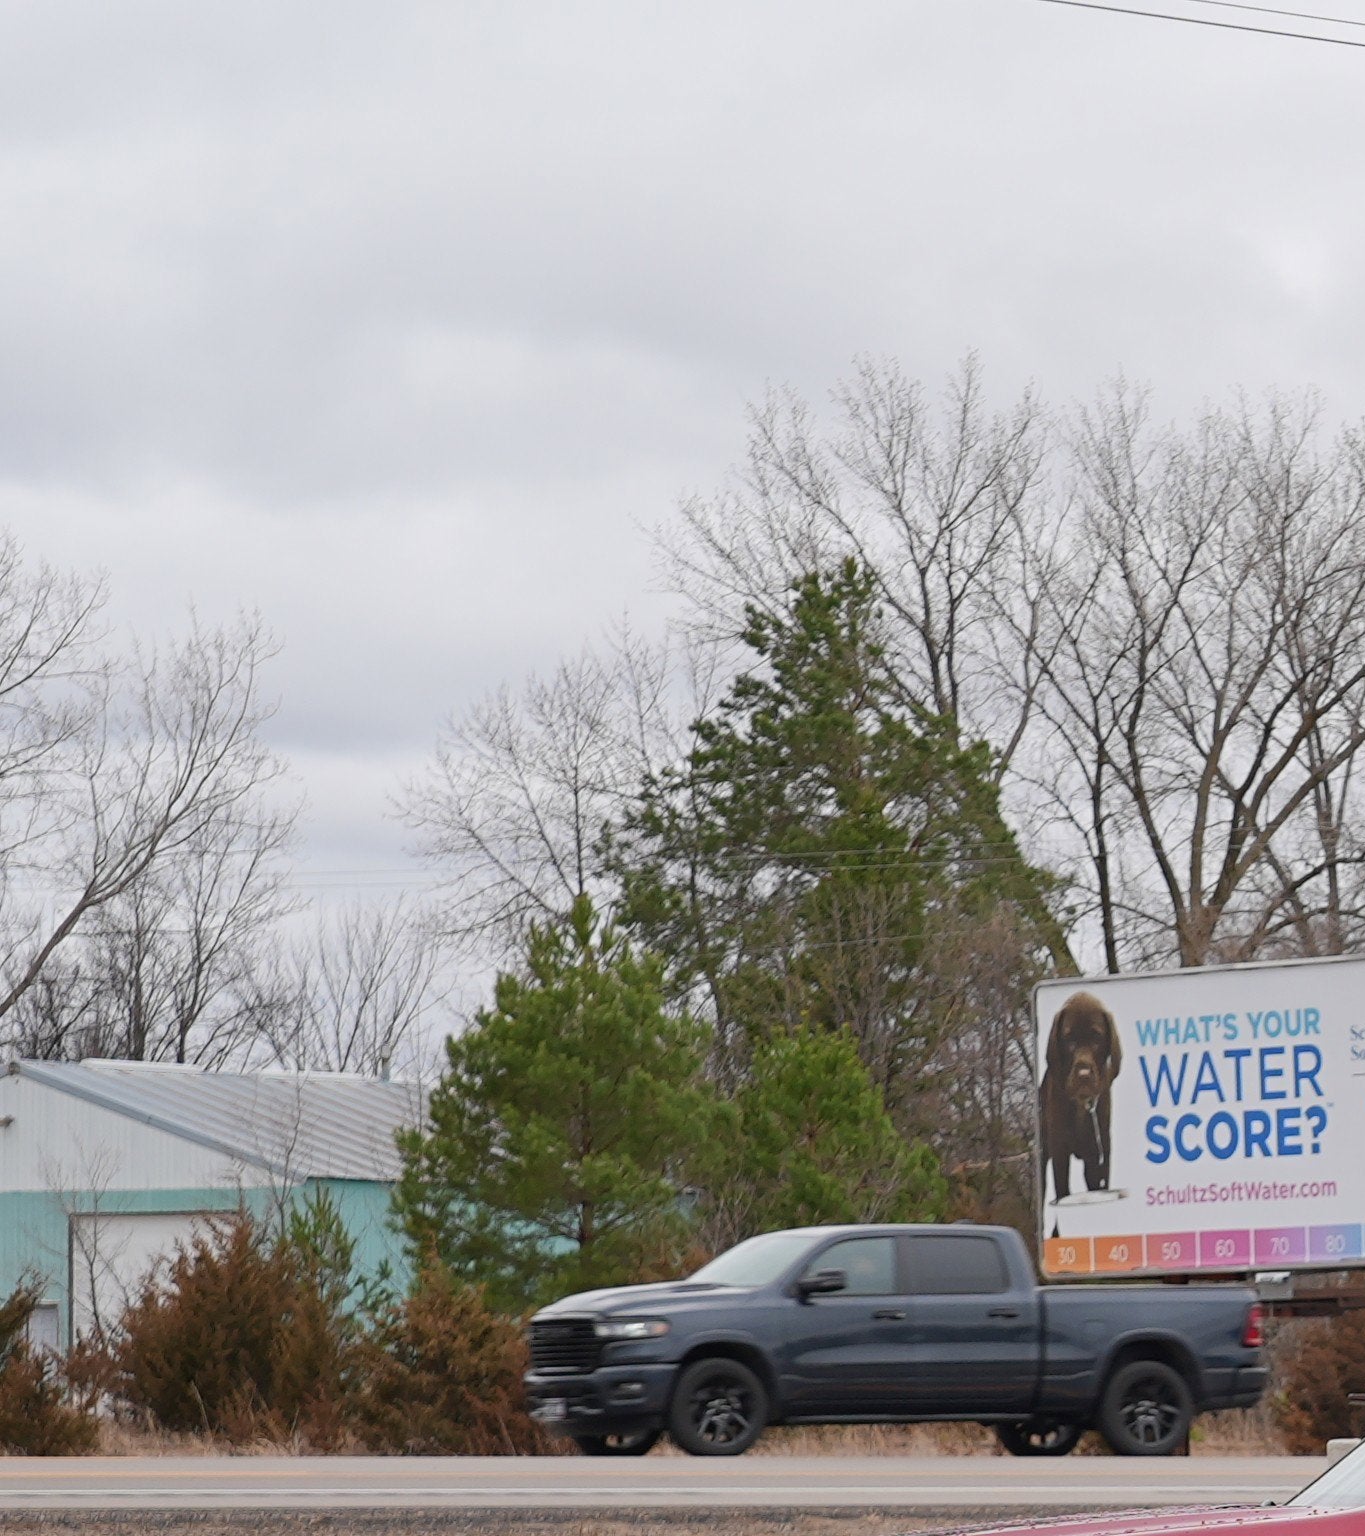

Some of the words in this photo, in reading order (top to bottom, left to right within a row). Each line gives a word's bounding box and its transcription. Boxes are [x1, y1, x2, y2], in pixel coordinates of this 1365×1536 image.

[1136, 1013, 1239, 1047] WHAT'S
[1246, 1007, 1321, 1040] YOUR
[1138, 1044, 1324, 1107] WATER
[1145, 1105, 1328, 1164] SCORE?
[1145, 1180, 1338, 1206] SchultzSoftWater.com
[1058, 1246, 1076, 1265] 30
[1108, 1243, 1129, 1263] 40
[1161, 1241, 1181, 1261] 50
[1215, 1239, 1236, 1258] 60
[1270, 1236, 1290, 1255] 70
[1325, 1234, 1346, 1253] 80
